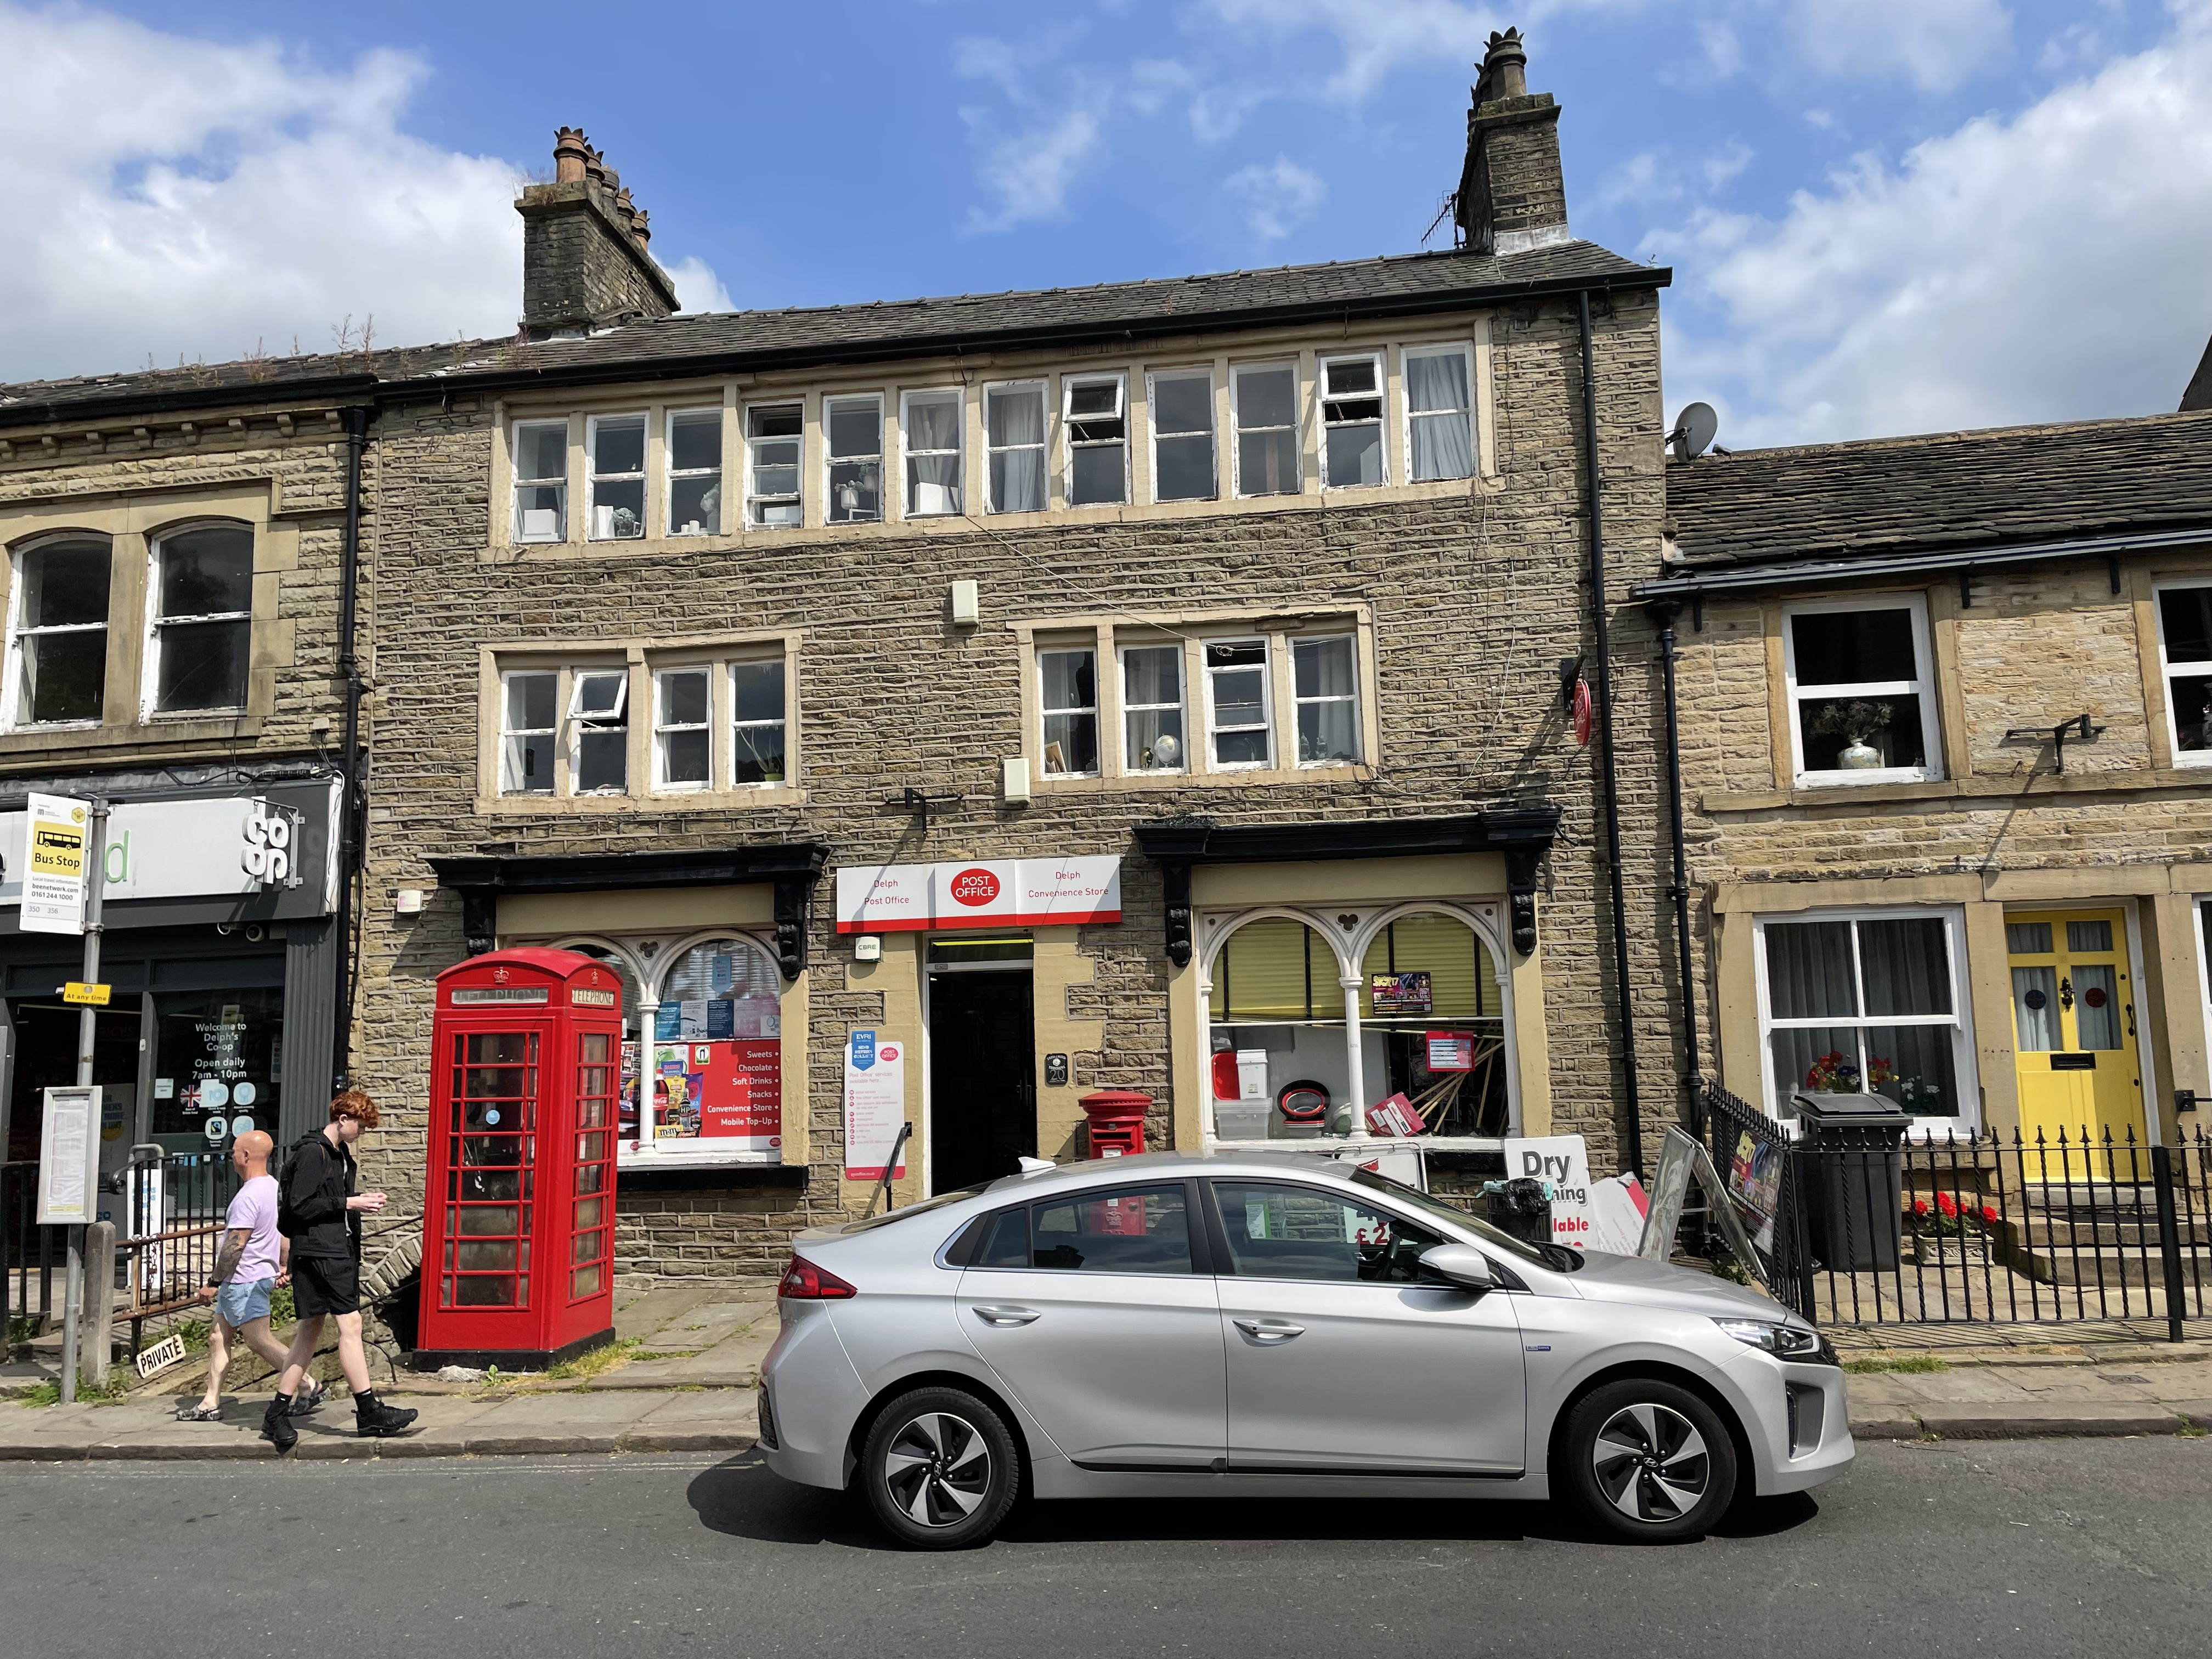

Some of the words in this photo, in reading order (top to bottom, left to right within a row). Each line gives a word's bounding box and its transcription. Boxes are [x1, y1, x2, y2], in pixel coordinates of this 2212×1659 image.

[35, 853, 53, 864] Bus
[57, 855, 80, 870] Stop
[1056, 871, 1080, 880] Delph
[874, 879, 898, 889] Delph
[962, 876, 990, 886] POST
[32, 883, 78, 893] beenetwork.com
[955, 887, 995, 898] OFFICE
[1029, 888, 1083, 898] Convenience
[885, 896, 909, 904] Office
[573, 989, 613, 1003] TELEPHONE
[195, 1023, 235, 1032] Welcome
[204, 1033, 239, 1042] Delph's
[206, 1043, 234, 1052] Co-op
[195, 1059, 220, 1069] Open
[223, 1057, 245, 1068] daily
[738, 1064, 772, 1072] Chocolate
[193, 1071, 212, 1080] 7am
[221, 1070, 247, 1080] 10pm
[1049, 1069, 1065, 1080] 20
[721, 1118, 744, 1126] Mobile
[746, 1117, 772, 1126] Top-Up
[1522, 1150, 1571, 1185] Dry
[1552, 1185, 1587, 1205] ning
[1554, 1217, 1589, 1232] lable
[140, 1337, 182, 1374] PRIVATE
